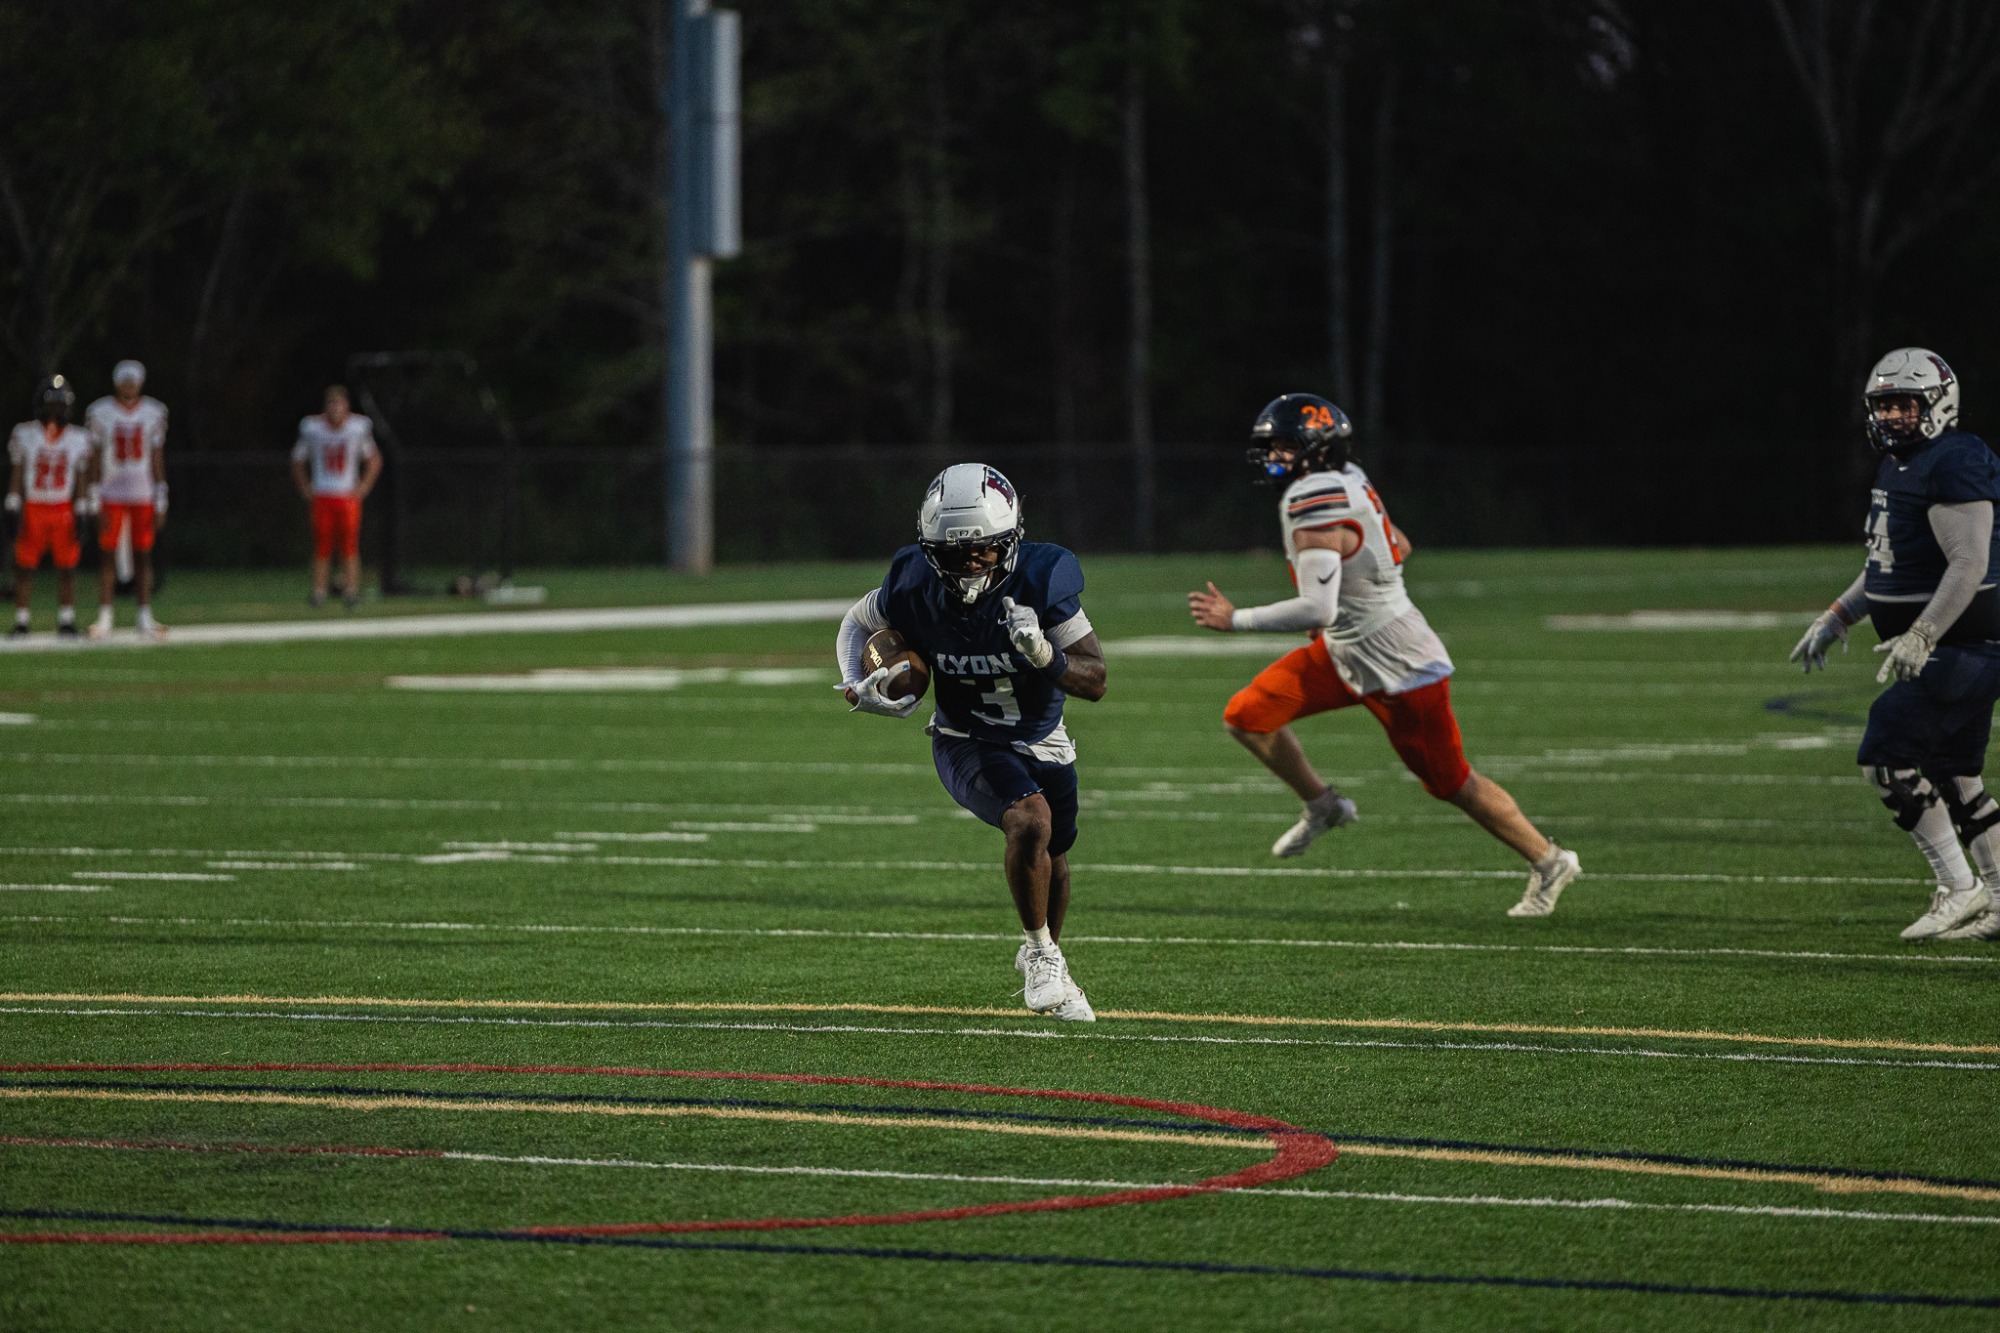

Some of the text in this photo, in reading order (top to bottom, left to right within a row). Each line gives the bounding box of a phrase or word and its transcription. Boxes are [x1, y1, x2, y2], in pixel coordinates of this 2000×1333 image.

[1301, 405, 1334, 429] 24
[936, 652, 1018, 674] LYON
[959, 676, 1022, 727] 3
